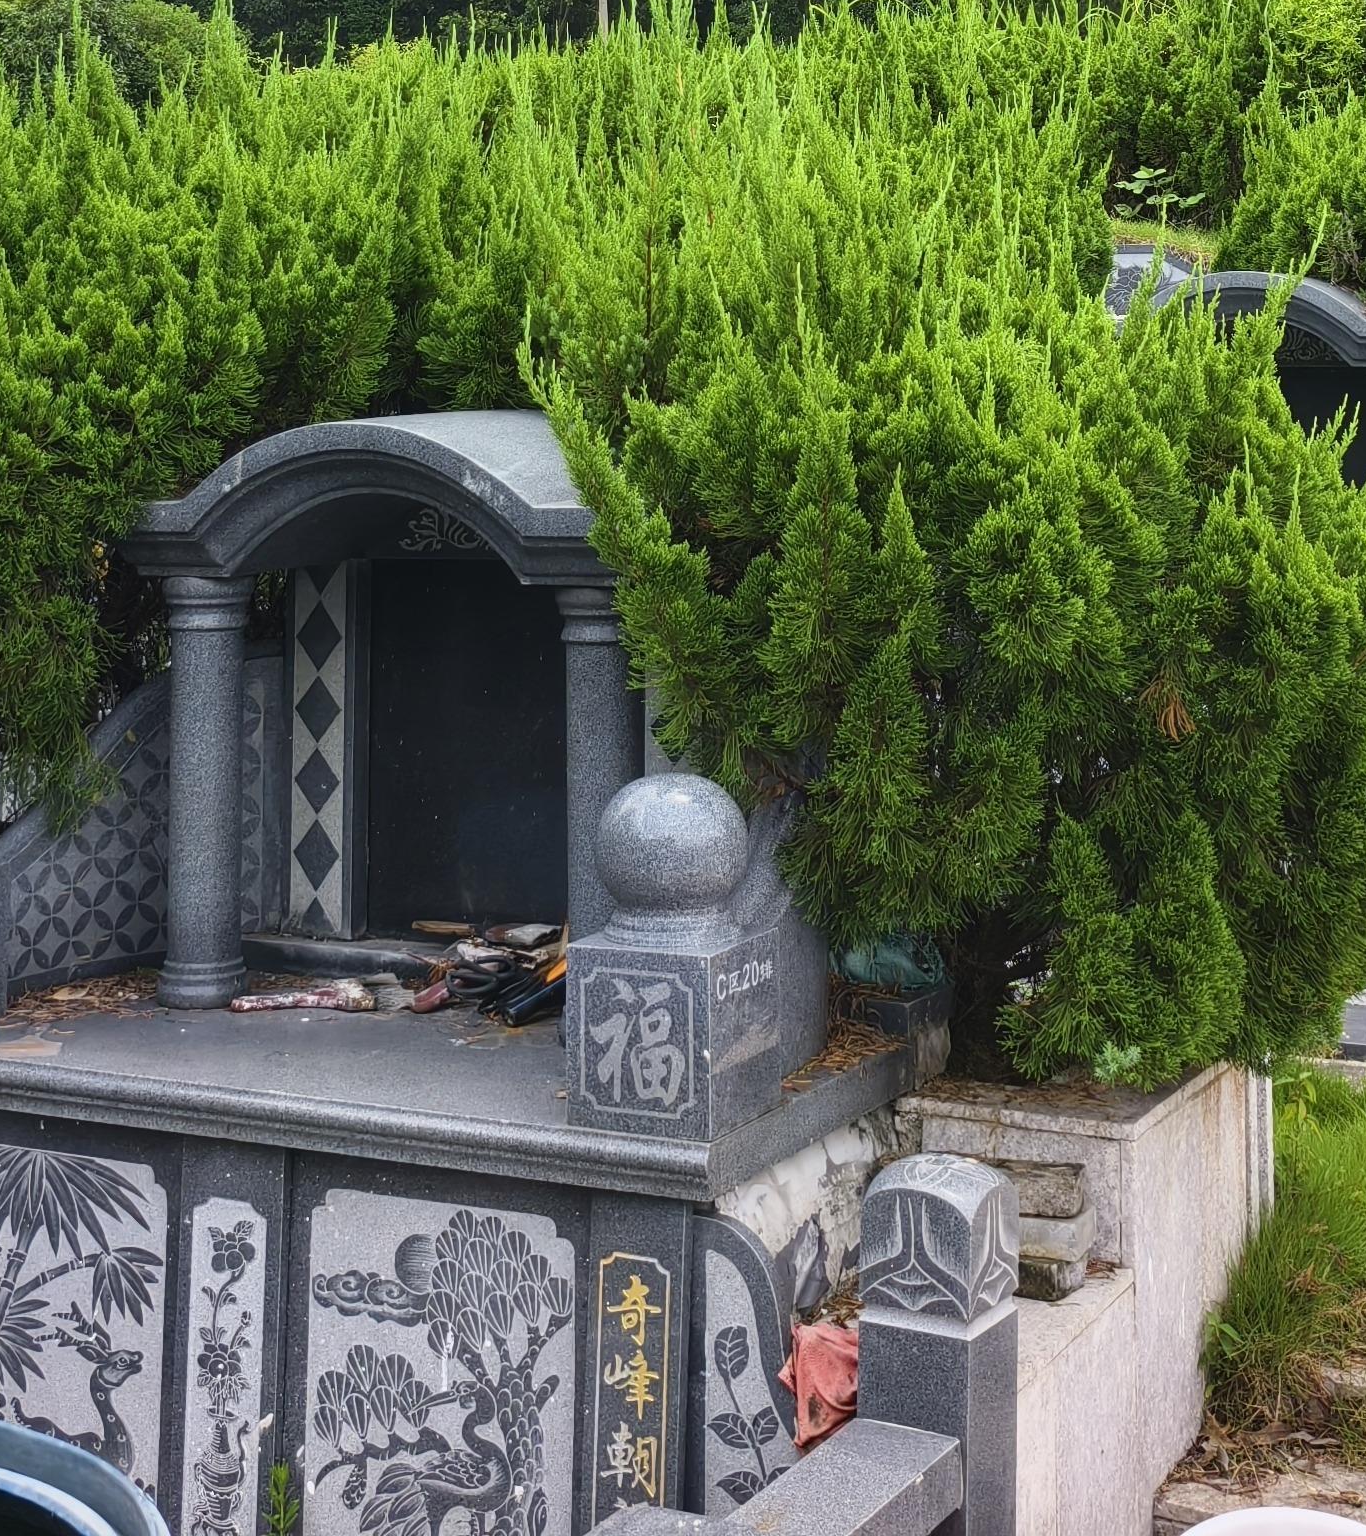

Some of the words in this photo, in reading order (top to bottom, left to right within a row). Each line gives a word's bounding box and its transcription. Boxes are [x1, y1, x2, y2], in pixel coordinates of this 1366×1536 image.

[588, 977, 685, 1107] 福
[600, 1274, 662, 1508] 奇峰朝
